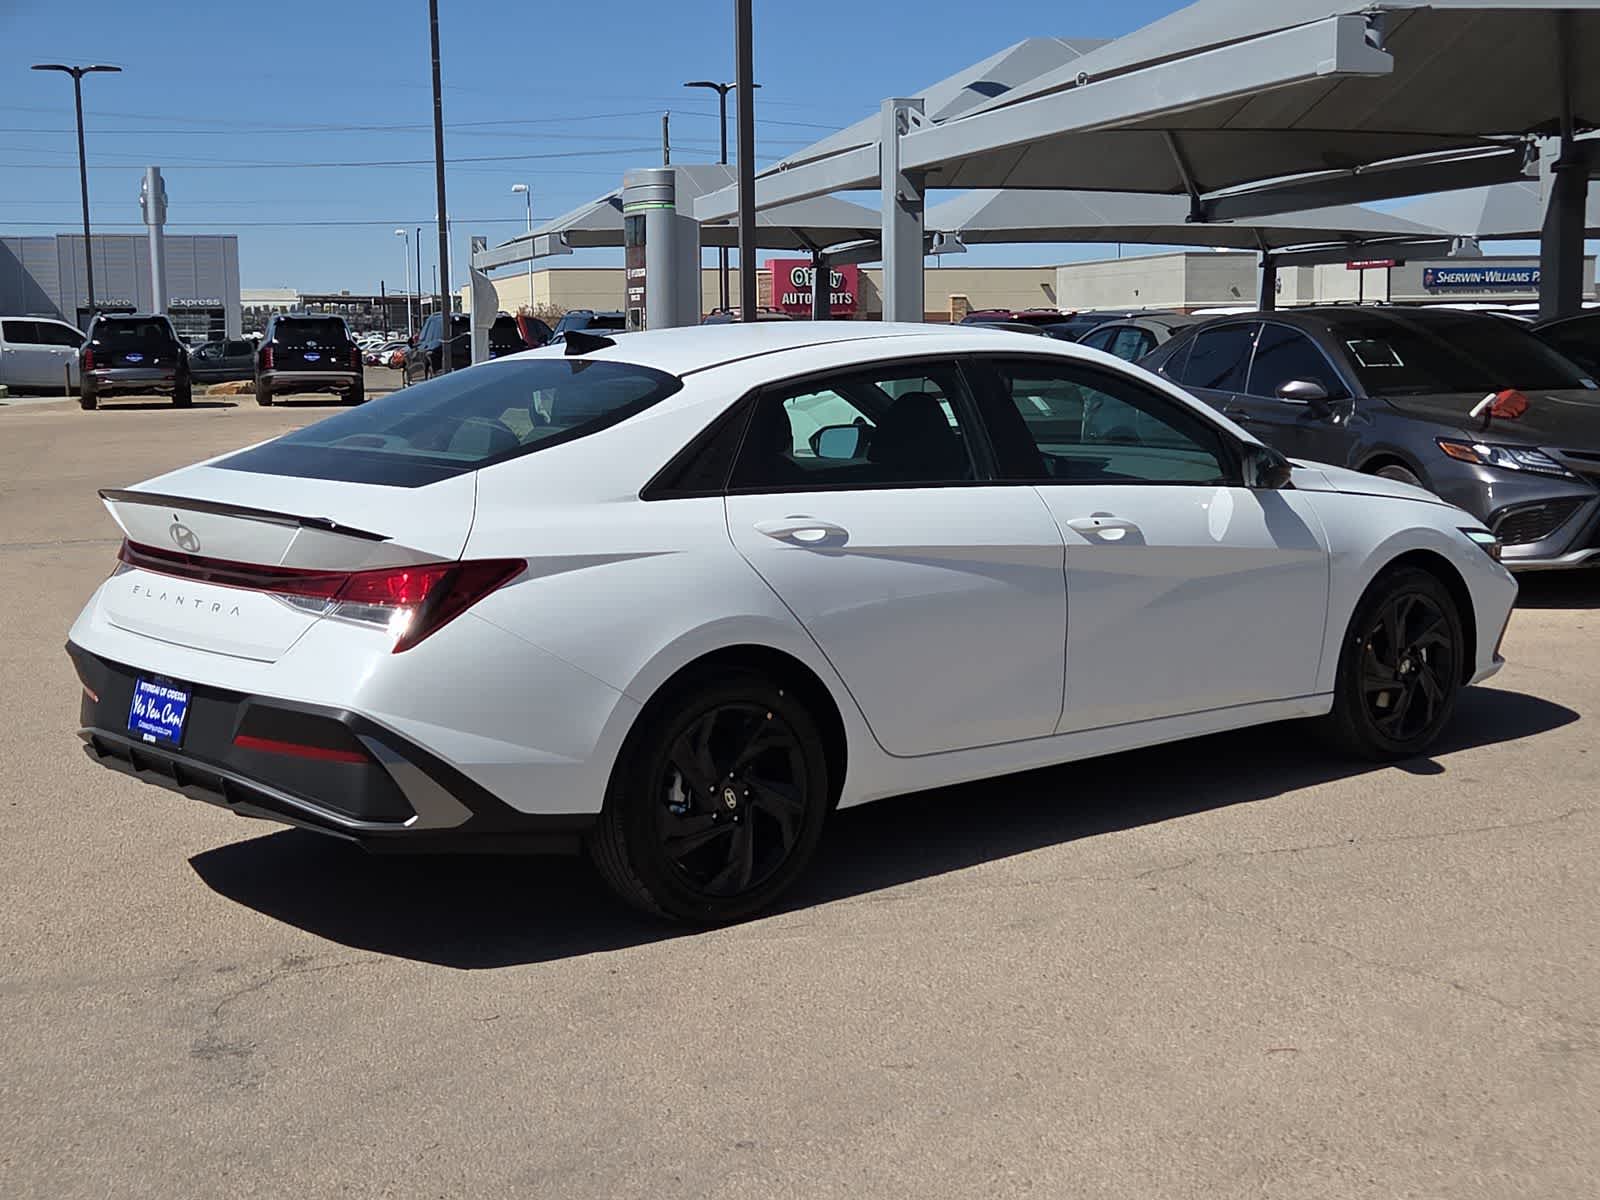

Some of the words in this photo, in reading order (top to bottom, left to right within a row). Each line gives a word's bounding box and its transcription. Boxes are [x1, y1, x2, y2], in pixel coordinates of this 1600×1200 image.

[170, 297, 220, 307] Express
[781, 292, 812, 305] AUTO
[829, 292, 853, 305] RTS
[132, 585, 240, 617] ELANTRA
[133, 694, 146, 716] Yes
[146, 697, 161, 719] You
[161, 703, 187, 728] Can!
